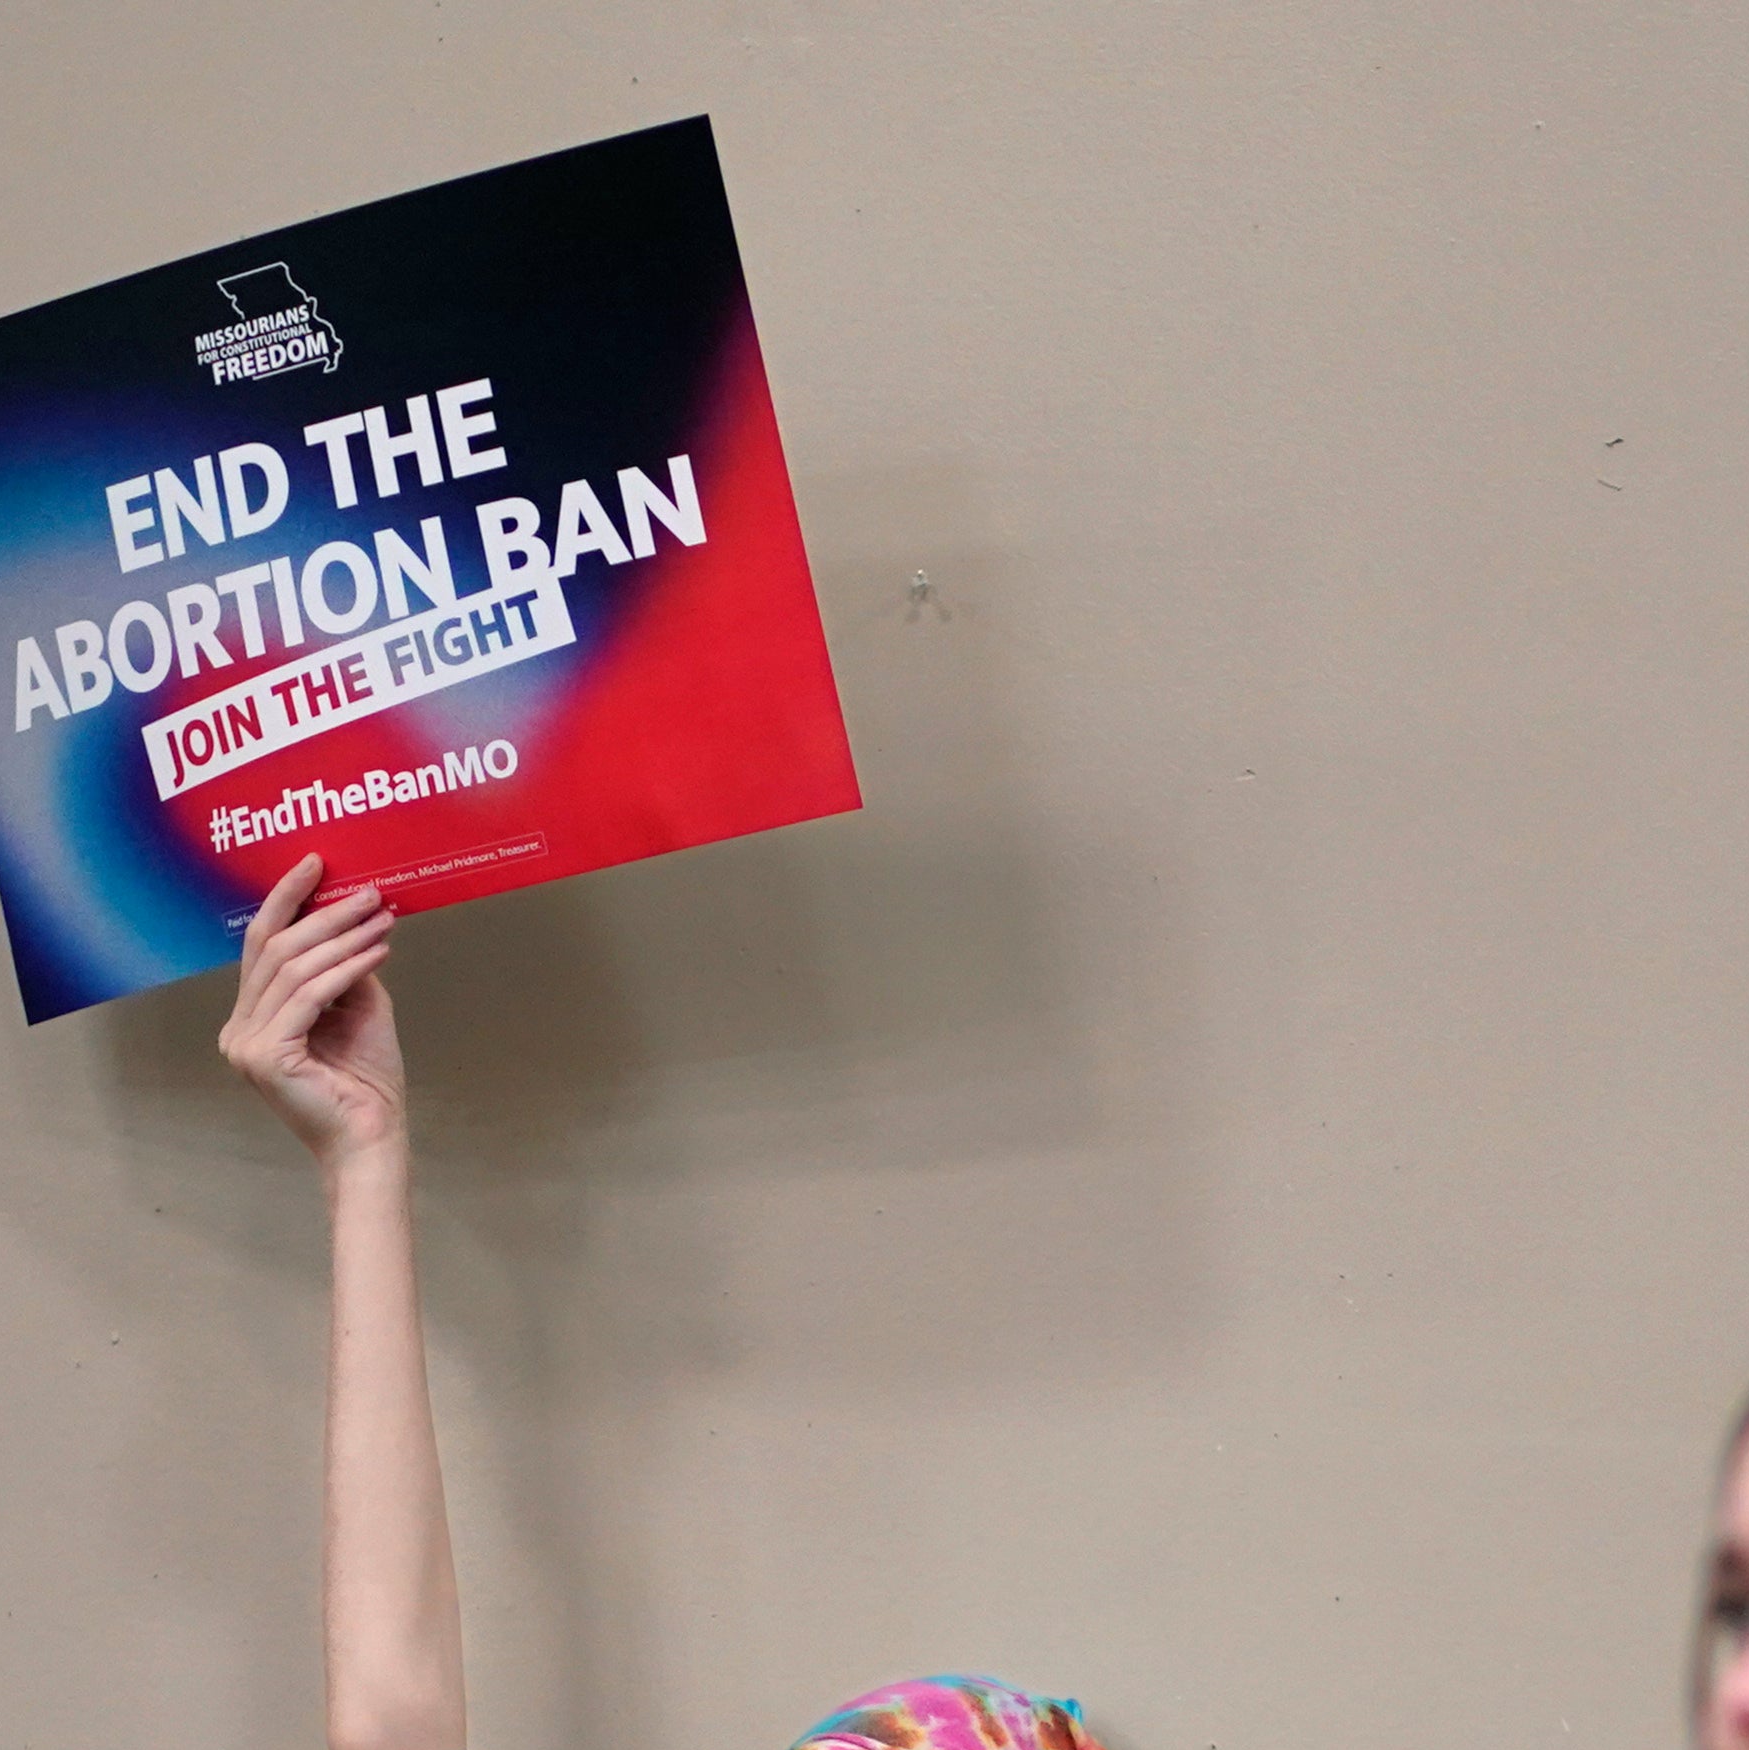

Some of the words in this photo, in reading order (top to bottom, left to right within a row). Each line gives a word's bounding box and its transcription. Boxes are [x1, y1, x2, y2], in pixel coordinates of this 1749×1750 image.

[194, 304, 310, 352] MISSOURIANS
[197, 350, 219, 365] FOR
[219, 323, 312, 359] CONSTITUTIONAL
[211, 331, 329, 386] FREEDOM
[105, 441, 290, 574] END
[304, 378, 507, 510] THE
[14, 516, 457, 732] ABORTION
[475, 454, 708, 592] BAN
[165, 696, 262, 786] JOIN
[271, 651, 374, 728] THE
[385, 590, 540, 687] FIGHT
[208, 738, 519, 853] #EndTheBanMO
[375, 869, 418, 889] Freedom,
[418, 860, 453, 878] Michael
